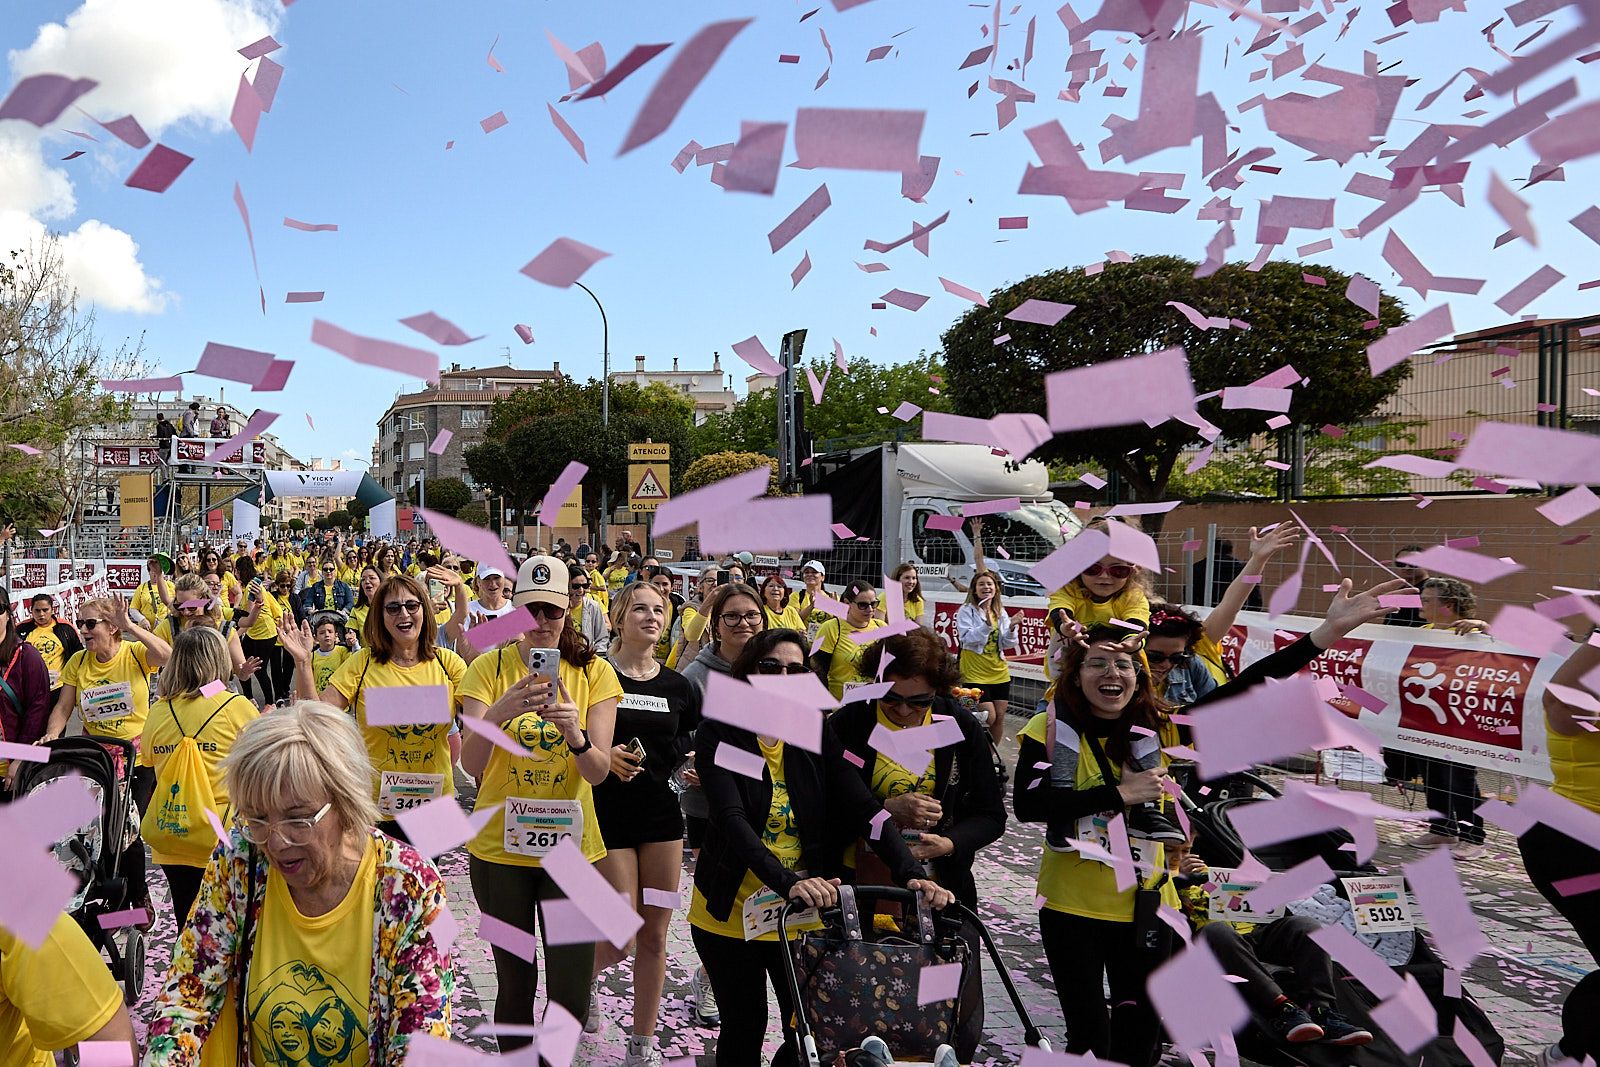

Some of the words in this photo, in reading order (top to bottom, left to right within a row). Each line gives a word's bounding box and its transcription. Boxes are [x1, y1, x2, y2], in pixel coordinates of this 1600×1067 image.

[633, 447, 667, 455] ATENCIÓ
[916, 566, 946, 575] ROINBENI
[1022, 617, 1046, 626] CURS
[1022, 627, 1034, 636] DE
[1038, 628, 1050, 636] LA
[1022, 636, 1051, 647] DONA
[1319, 648, 1358, 663] URSA
[1310, 660, 1328, 673] DE
[1455, 664, 1521, 685] CURSA
[84, 690, 94, 700] XV
[1450, 679, 1479, 693] DE
[1488, 684, 1516, 699] LA
[98, 702, 127, 714] 1320
[624, 698, 667, 708] TWORKER
[1330, 698, 1351, 706] OODS
[1448, 693, 1515, 715] DONA
[1473, 714, 1511, 726] VICKY
[1477, 724, 1500, 733] FOO
[153, 742, 217, 754] BONITES
[385, 774, 400, 786] XV
[395, 798, 431, 810] 341
[510, 801, 528, 815] XV
[526, 831, 572, 847] 261
[1213, 871, 1230, 883] XV
[1347, 881, 1362, 893] XV
[1369, 907, 1404, 922] 5192
